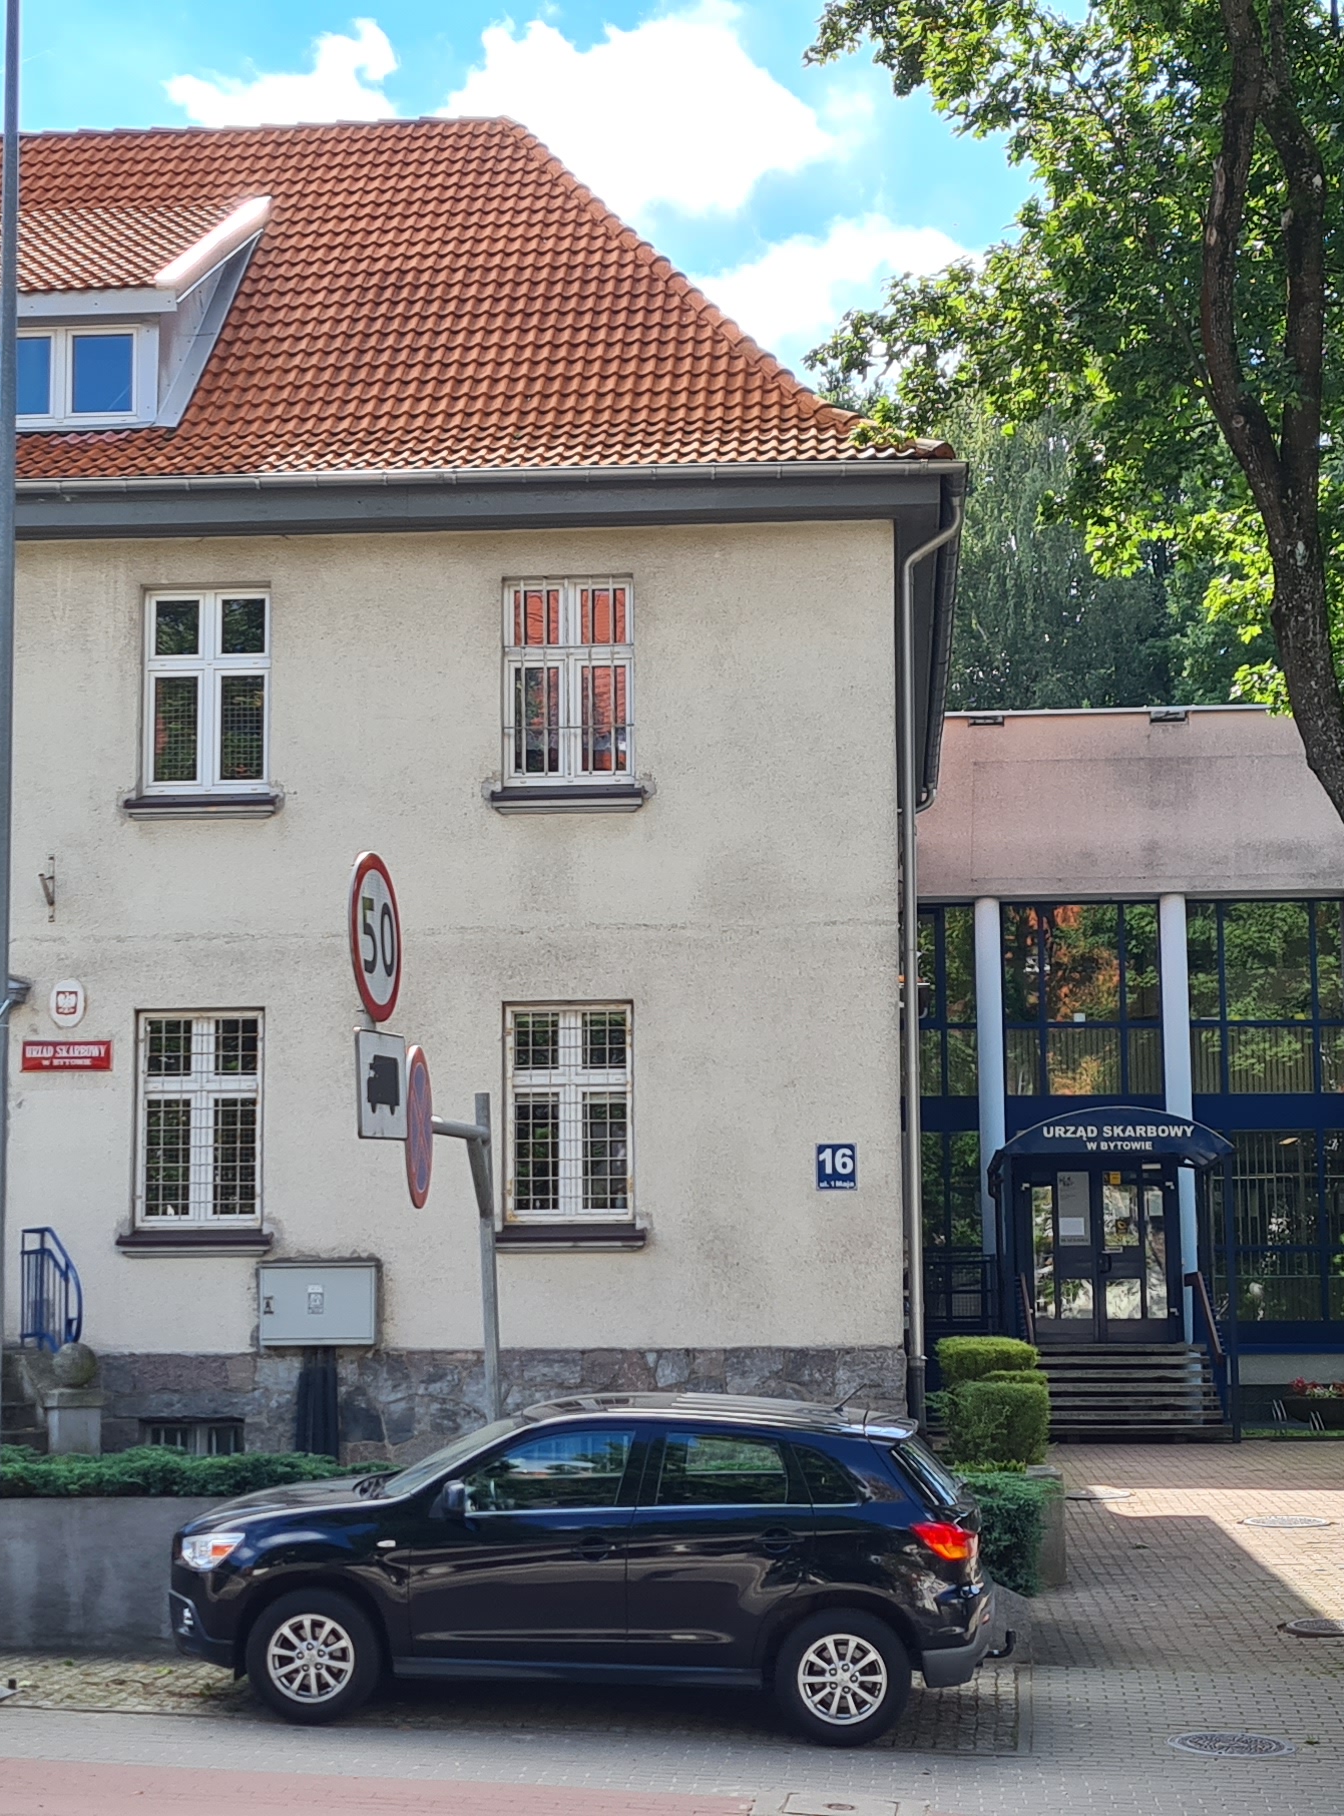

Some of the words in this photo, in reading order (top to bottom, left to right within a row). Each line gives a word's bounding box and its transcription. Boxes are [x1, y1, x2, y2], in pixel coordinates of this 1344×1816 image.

[361, 896, 395, 978] 50
[55, 1045, 108, 1058] SKARBOWY
[1042, 1126, 1098, 1141] URZĄD
[1102, 1125, 1195, 1137] SKARBOWY
[1086, 1141, 1098, 1151] W
[1100, 1141, 1153, 1150] BYTOWIE
[818, 1148, 854, 1175] 16
